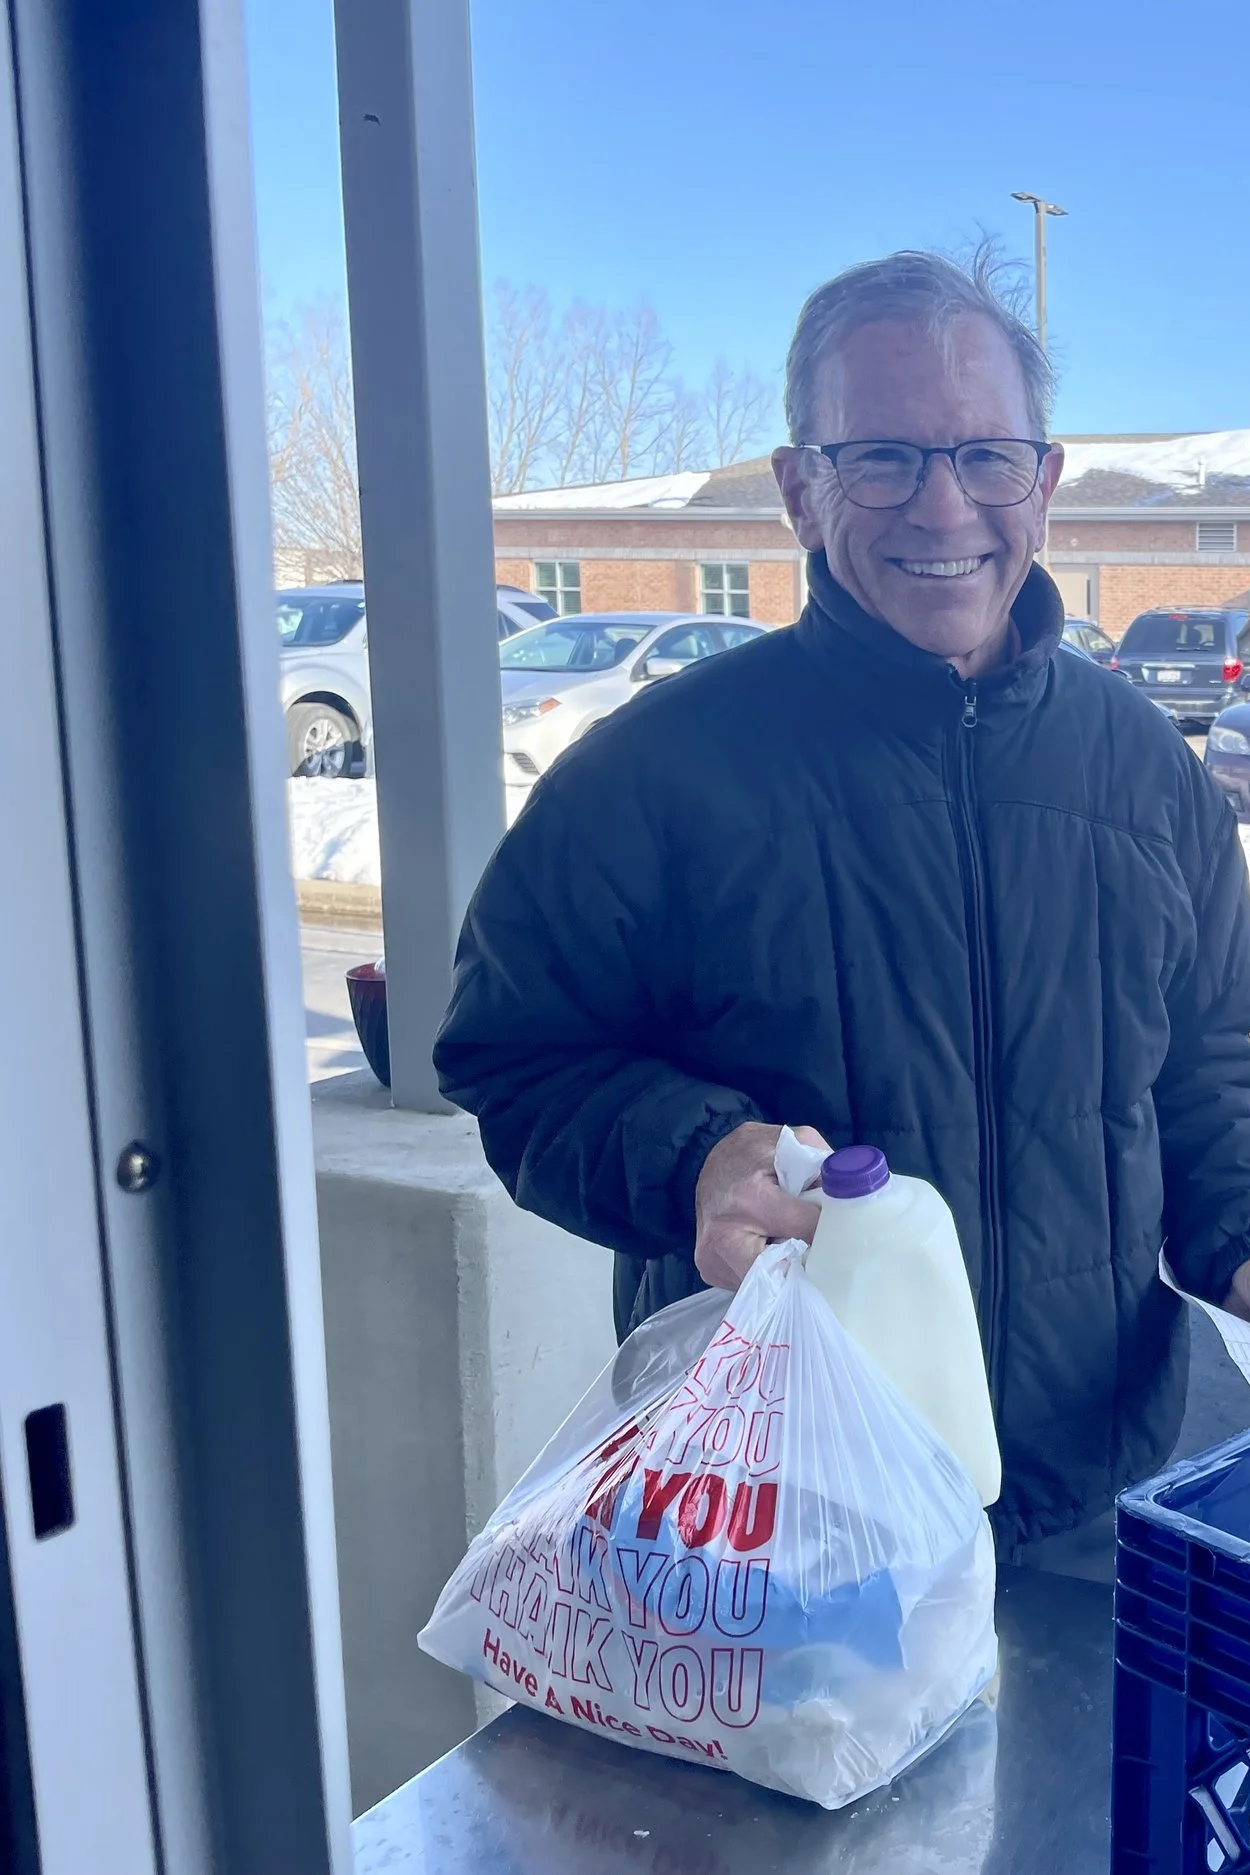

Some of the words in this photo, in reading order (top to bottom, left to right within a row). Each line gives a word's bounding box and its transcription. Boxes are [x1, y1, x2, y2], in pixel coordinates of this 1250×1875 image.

[693, 1320, 790, 1406] YOU
[665, 1398, 784, 1477] YOU
[636, 1467, 779, 1552] YOU
[617, 1548, 771, 1638] YOU
[483, 1628, 538, 1697] Have
[545, 1686, 565, 1715] A
[570, 1696, 642, 1736] Nice
[645, 1725, 728, 1760] Day!
[621, 1630, 764, 1728] YOU
